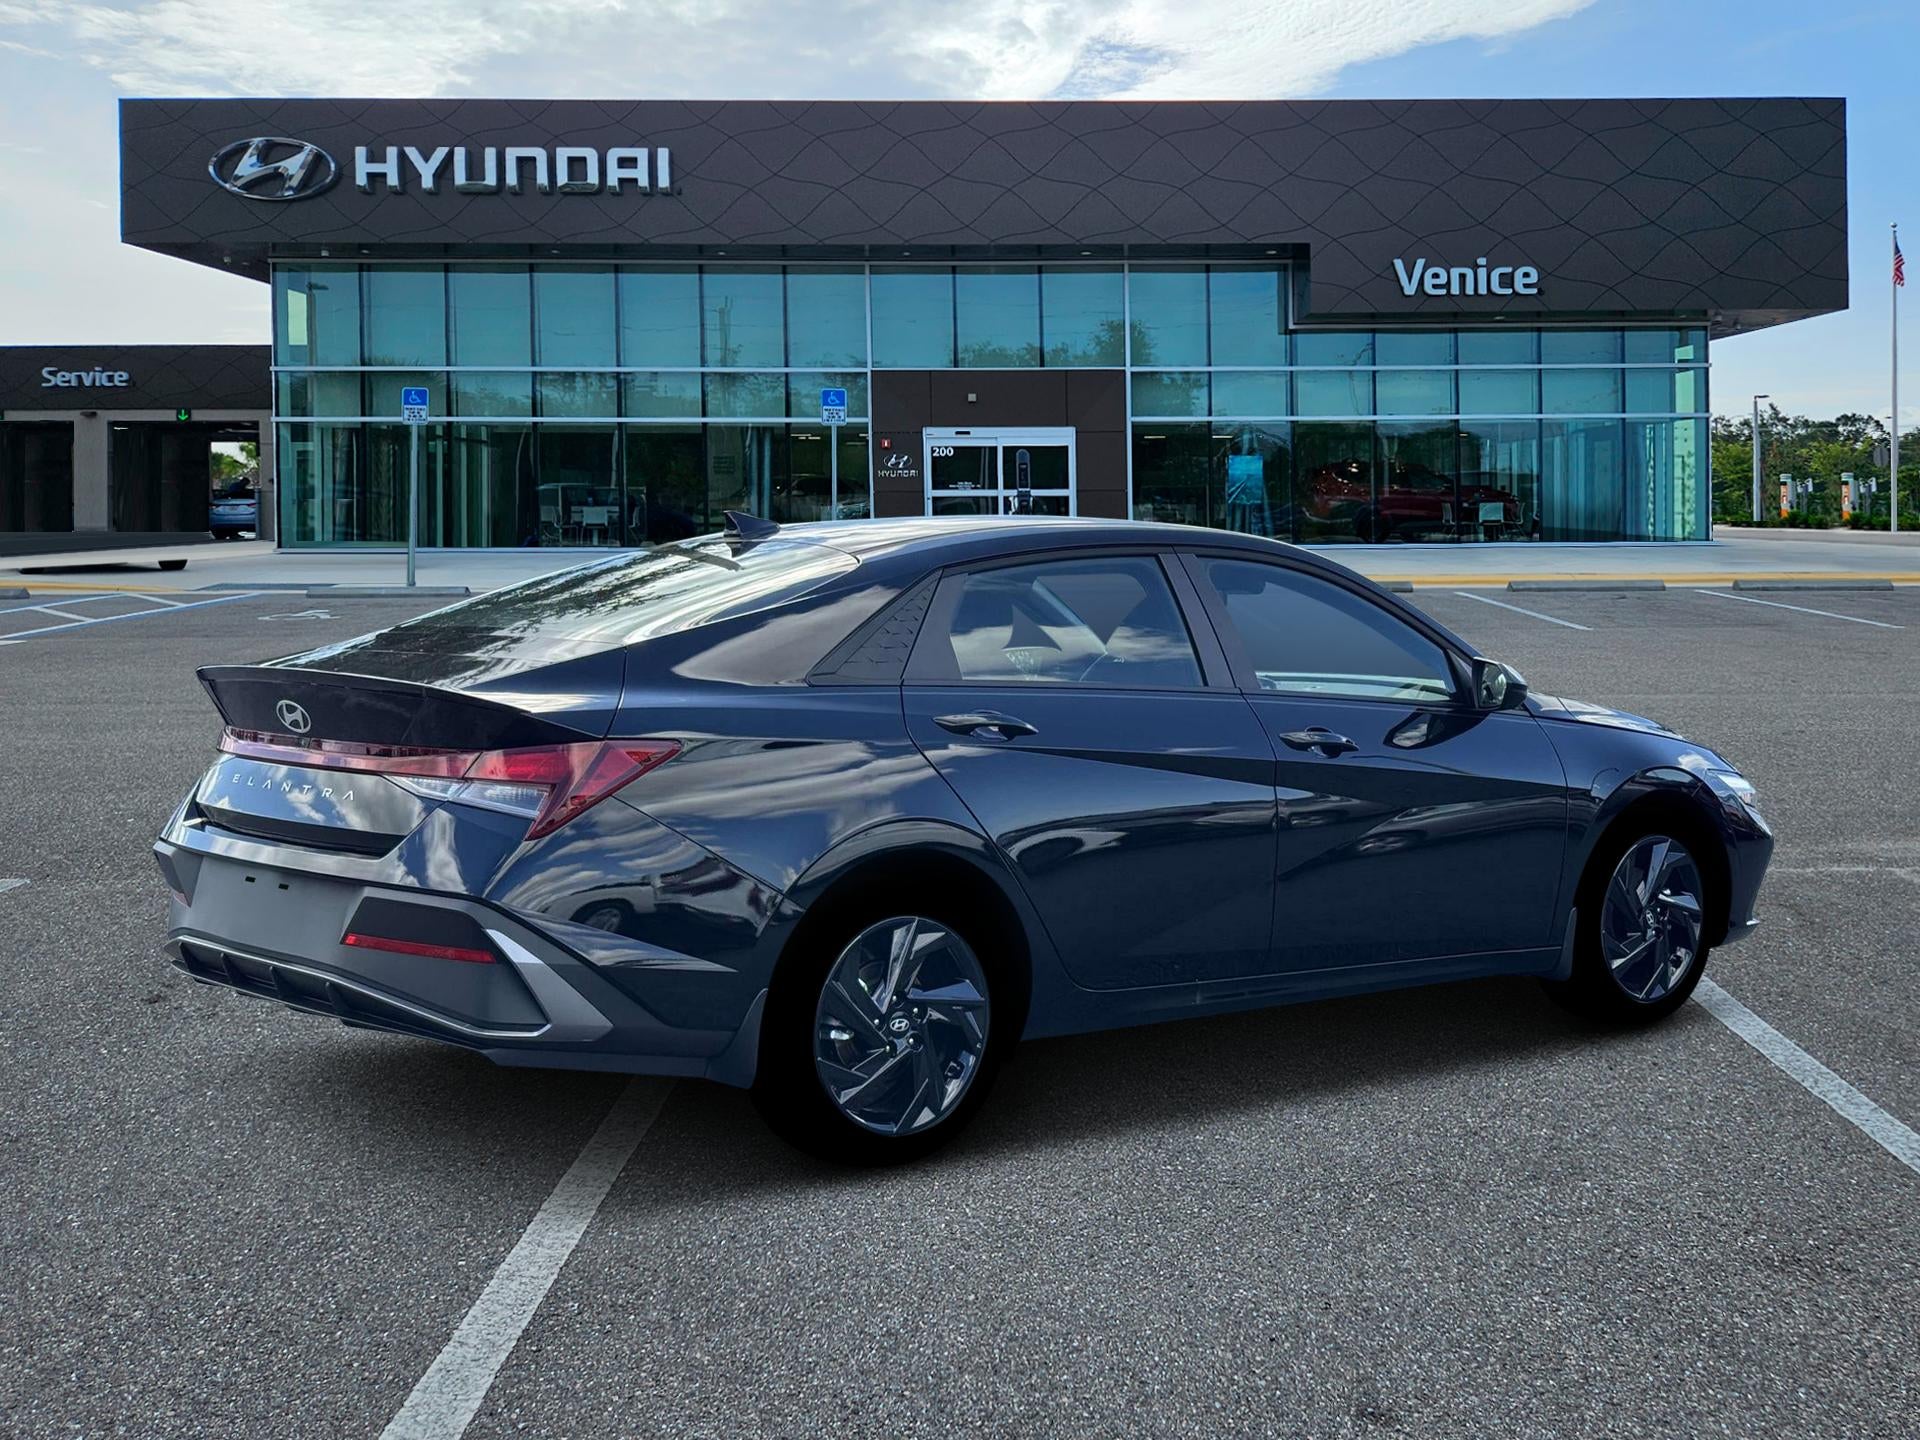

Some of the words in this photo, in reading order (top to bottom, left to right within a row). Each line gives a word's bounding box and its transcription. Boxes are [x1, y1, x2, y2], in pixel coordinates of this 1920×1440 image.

[354, 146, 671, 195] HYUNDAI
[1392, 257, 1540, 296] Venice
[41, 366, 130, 387] Service
[932, 446, 954, 457] 200
[877, 469, 919, 478] HYUNDAI
[231, 773, 355, 801] ELANTRA
